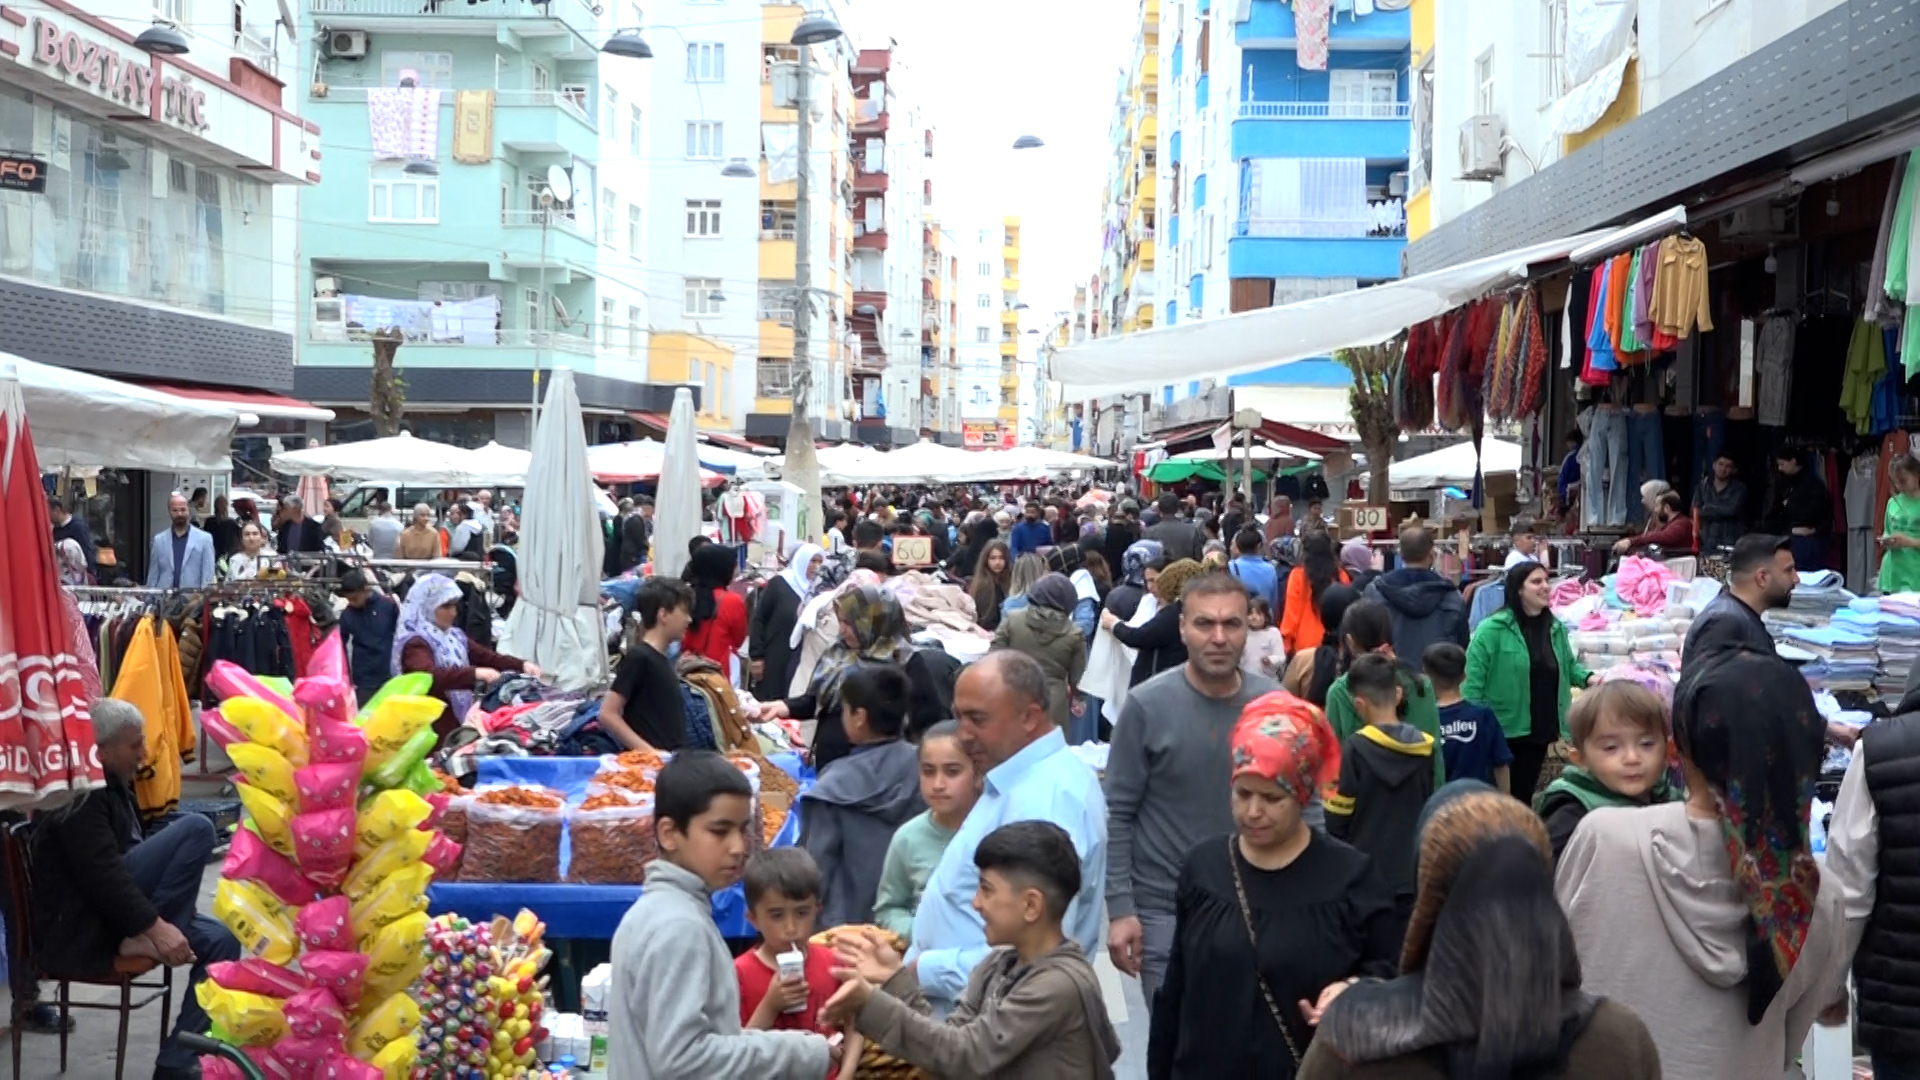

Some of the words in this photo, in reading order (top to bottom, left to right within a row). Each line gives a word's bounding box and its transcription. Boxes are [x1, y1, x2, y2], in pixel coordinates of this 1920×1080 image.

[34, 16, 155, 105] BOZTAY
[1357, 509, 1379, 526] 80
[897, 539, 926, 560] 60
